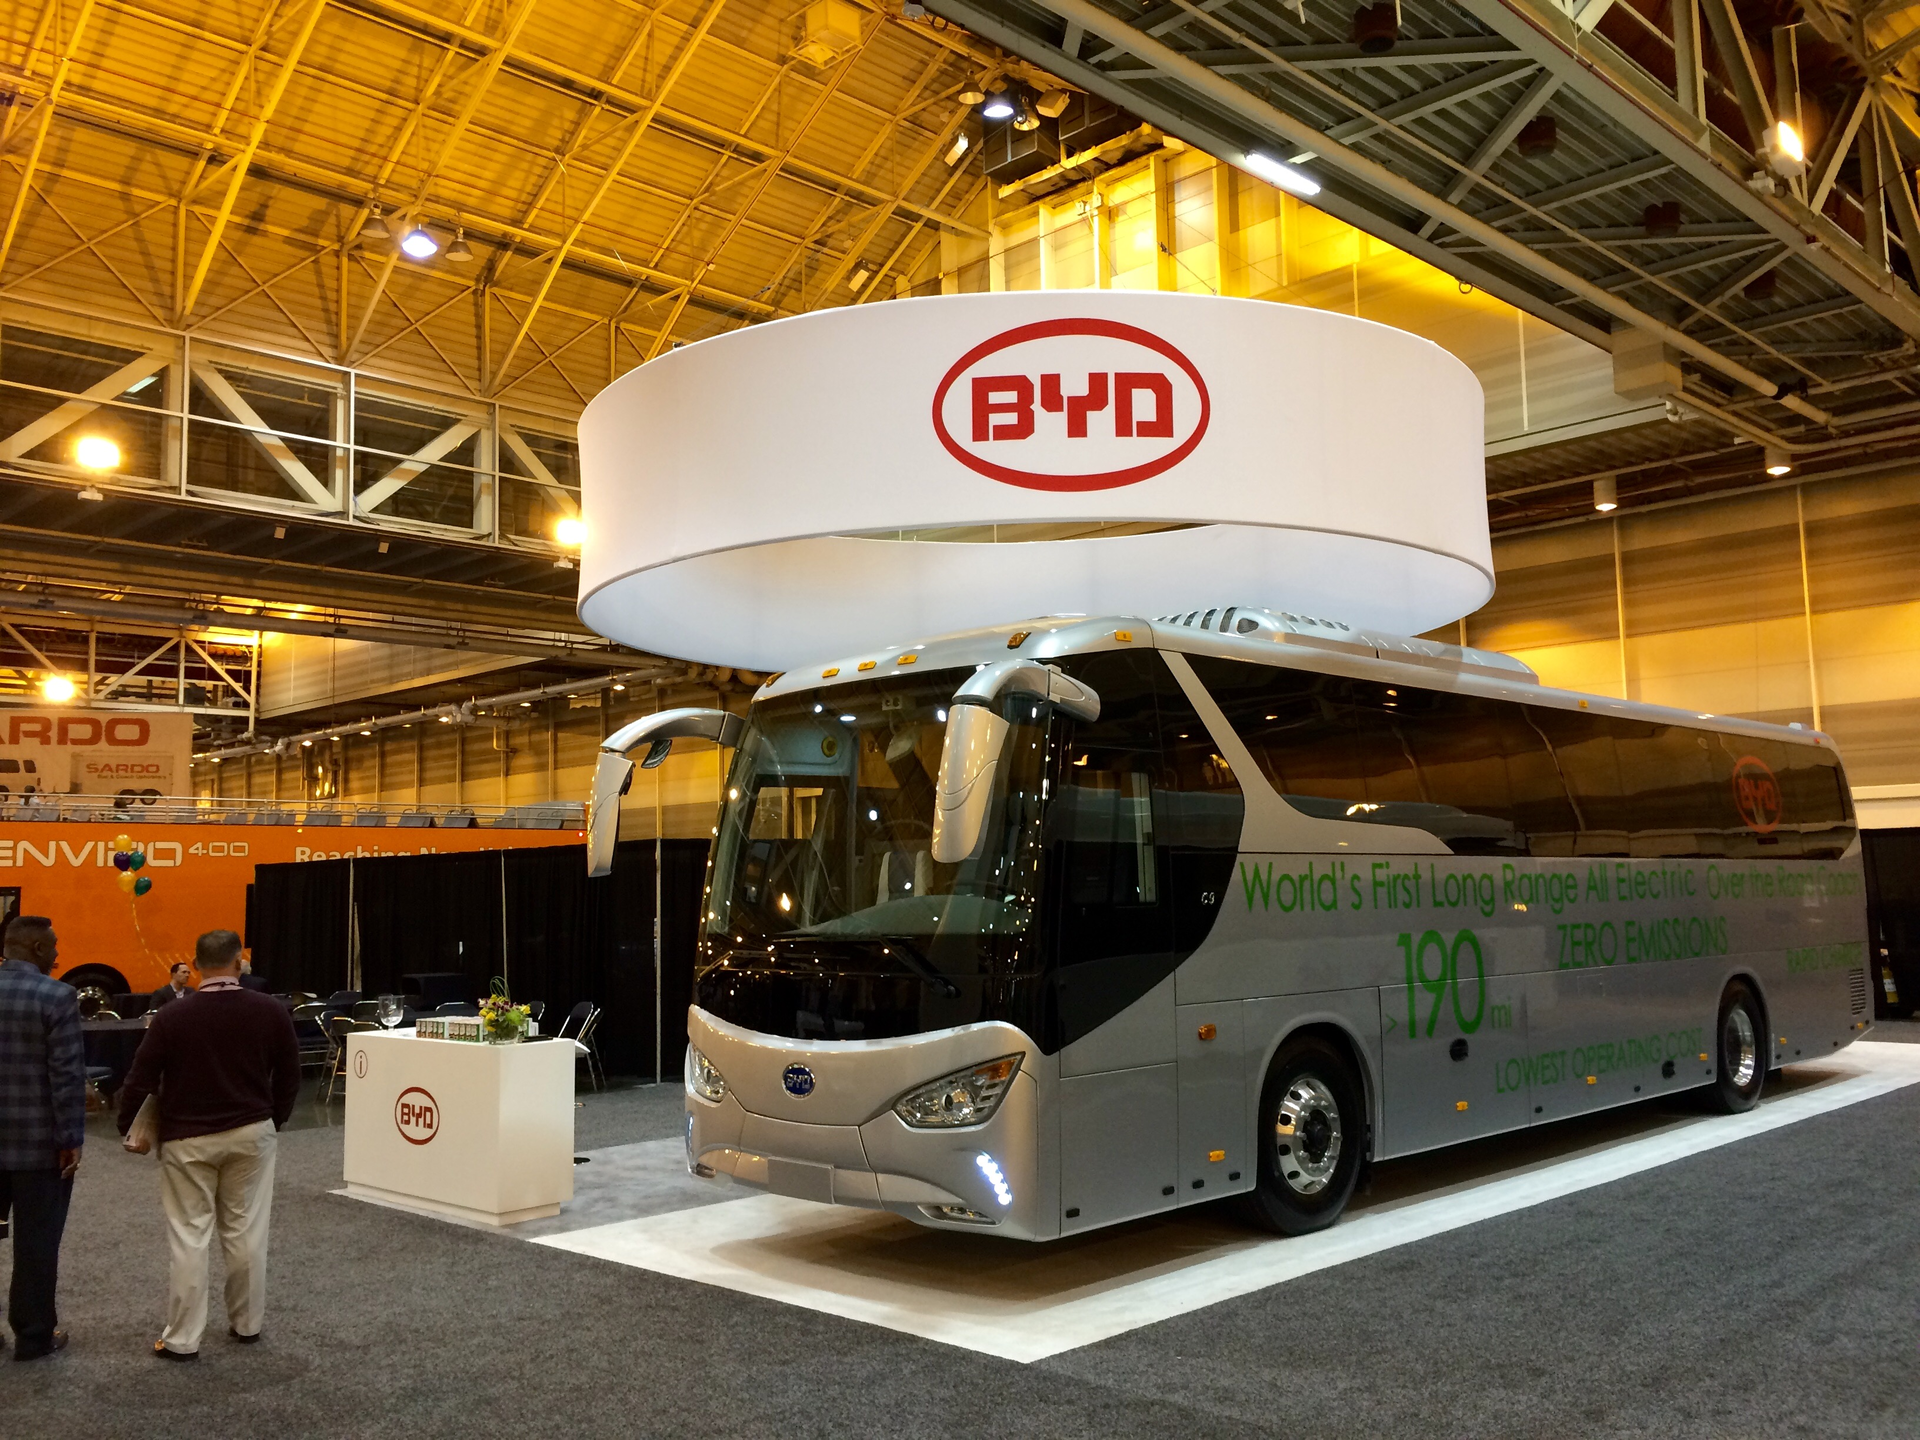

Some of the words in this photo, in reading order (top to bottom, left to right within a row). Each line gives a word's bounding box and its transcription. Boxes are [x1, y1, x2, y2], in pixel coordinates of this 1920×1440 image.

[971, 372, 1174, 442] BYD
[0, 715, 150, 746] RDO
[85, 763, 160, 774] SARDO
[1738, 778, 1777, 810] BYD
[188, 841, 249, 857] 400
[1239, 861, 1364, 913] World's
[1371, 861, 1422, 910] First
[1430, 862, 1496, 918] Long
[1502, 863, 1578, 915] Range
[1586, 862, 1609, 902] All
[1615, 861, 1697, 902] Electric
[1706, 864, 1746, 900] Over
[1749, 865, 1774, 898] the
[1776, 865, 1815, 898] Road
[1556, 920, 1618, 969] ZERO
[1624, 915, 1729, 964] EMISSIONS
[1396, 928, 1486, 1039] 190
[1490, 995, 1512, 1030] mi
[1494, 1051, 1567, 1094] LOWEST
[1572, 1034, 1662, 1080] OPERATING
[1665, 1027, 1704, 1061] COST
[785, 1073, 811, 1089] BYD
[400, 1102, 434, 1130] BYD
